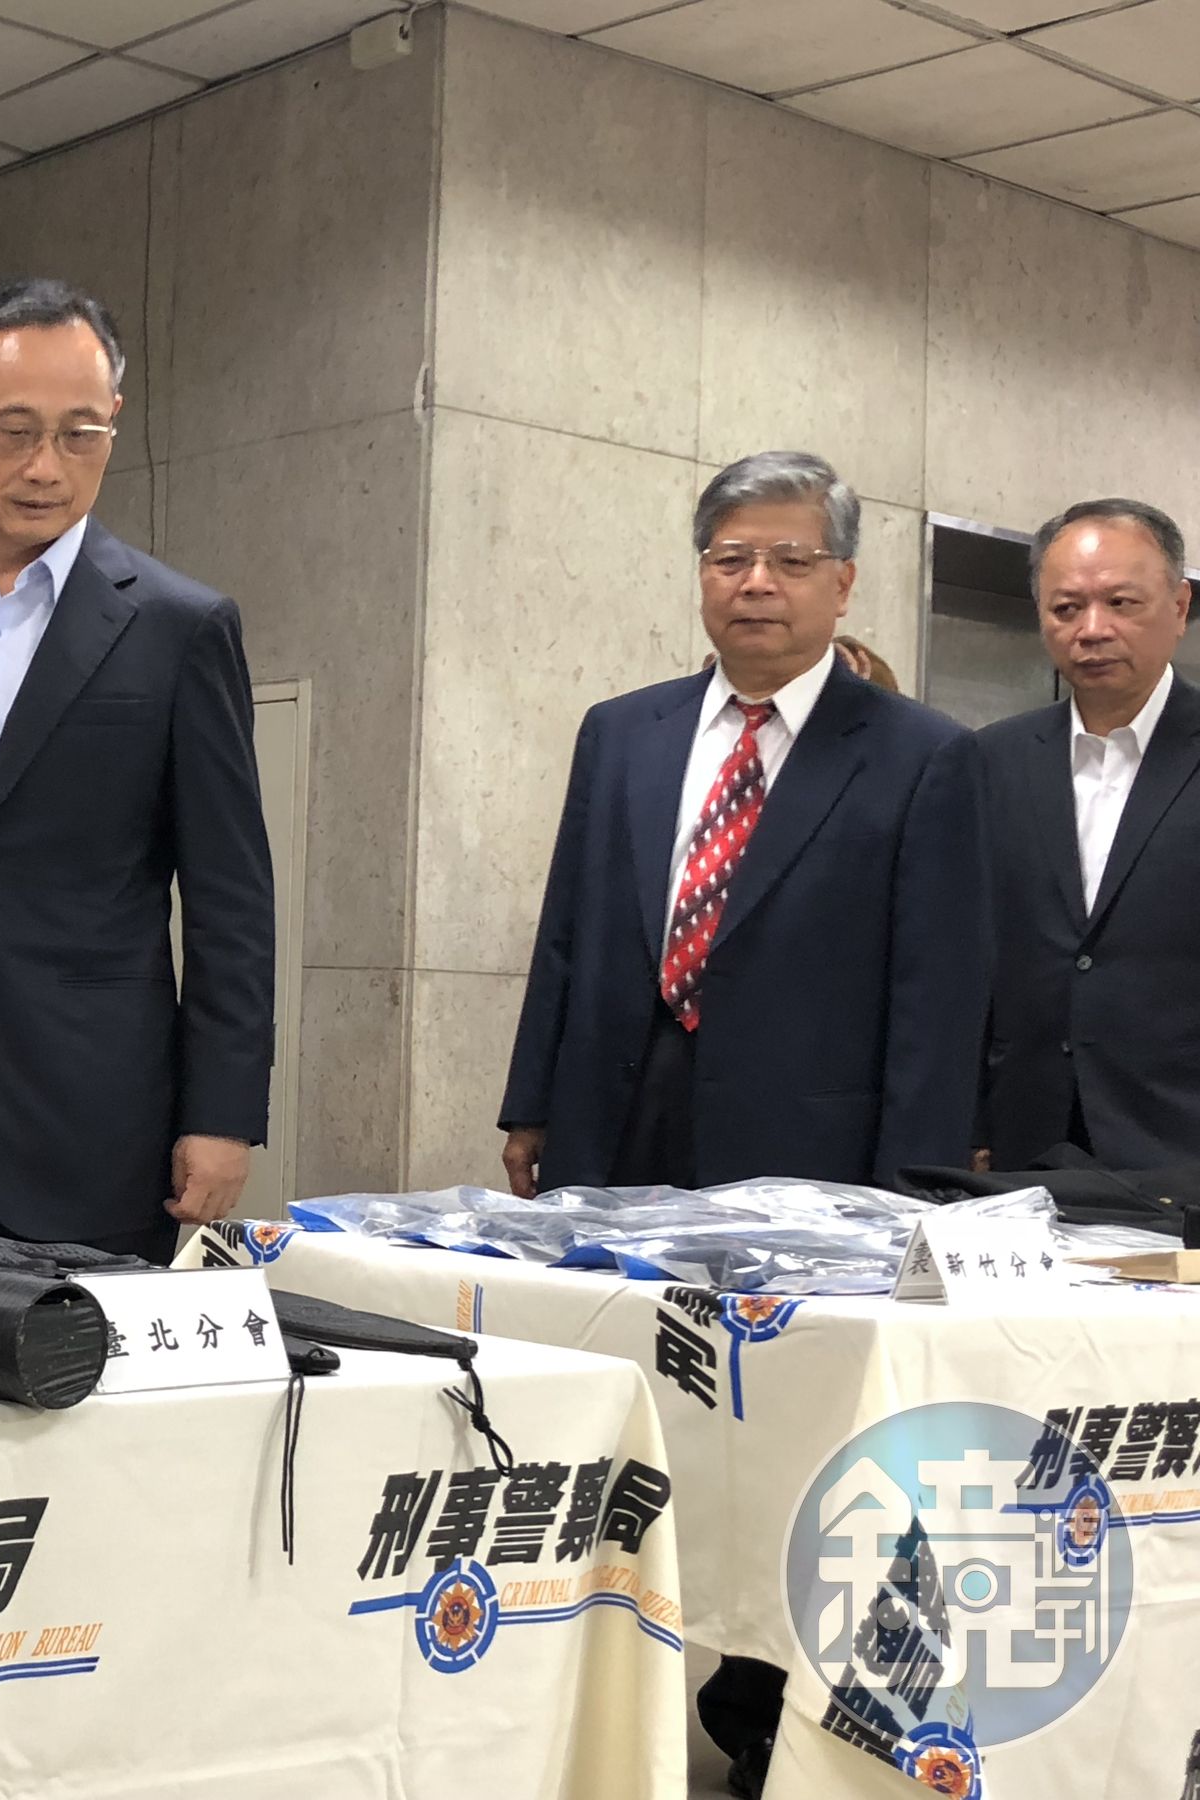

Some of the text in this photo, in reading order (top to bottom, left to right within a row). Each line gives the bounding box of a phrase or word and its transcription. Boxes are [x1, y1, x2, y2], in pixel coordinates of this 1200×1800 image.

[945, 1251, 1054, 1278] 新竹分會
[106, 1309, 269, 1359] 臺北分會
[1014, 1397, 1200, 1490] 刑事警察
[356, 1456, 672, 1580] 刑事警察局
[500, 1578, 573, 1608] CRIMINAL
[31, 1623, 103, 1657] BUREAU
